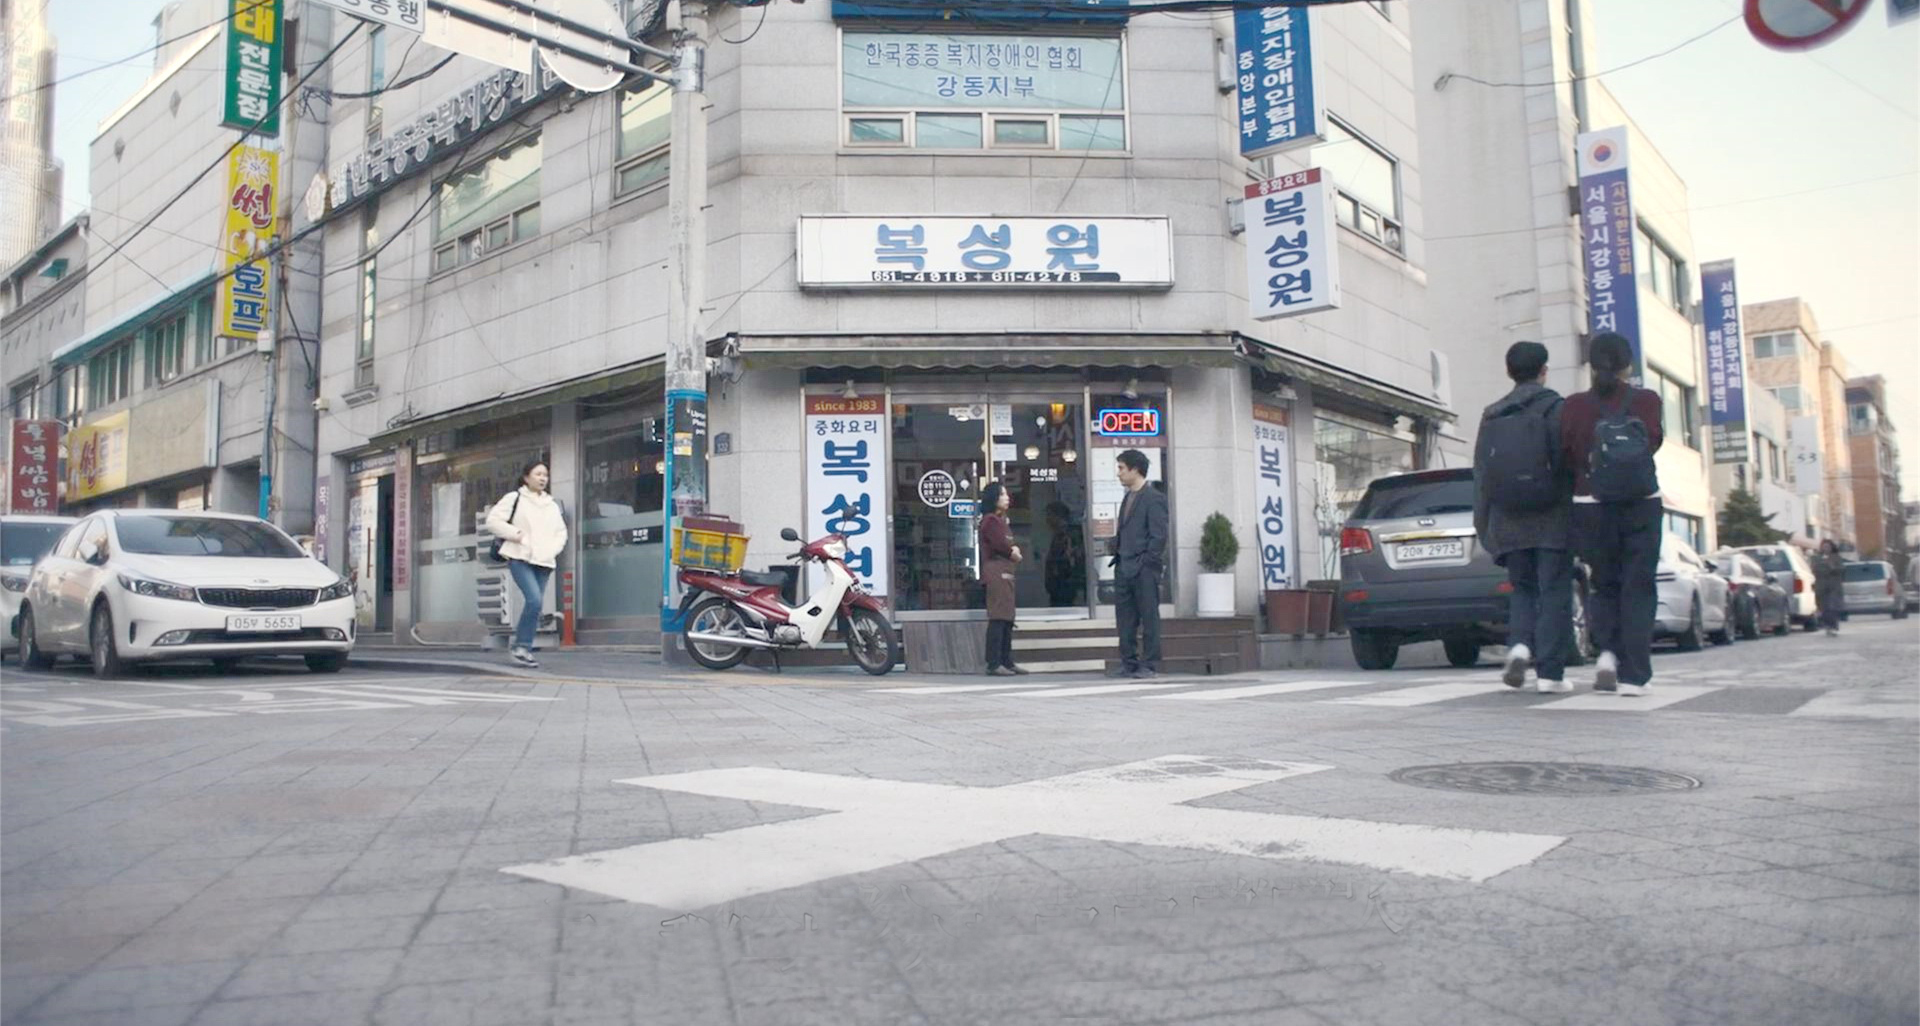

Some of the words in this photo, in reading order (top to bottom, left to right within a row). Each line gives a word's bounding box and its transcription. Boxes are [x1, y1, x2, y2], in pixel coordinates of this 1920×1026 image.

[234, 0, 275, 43] 태
[1047, 46, 1082, 70] 협회
[237, 41, 272, 123] 전문점
[937, 76, 1035, 98] 강동지부
[1239, 50, 1258, 137] 중앙본부
[1259, 172, 1307, 196] 중화요리
[231, 183, 272, 229] 썬
[874, 223, 1100, 271] 복성원
[1264, 191, 1313, 308] 복성원
[231, 263, 266, 333] 호프
[814, 401, 845, 411] since
[849, 400, 877, 411] 1983
[1103, 412, 1156, 432] OPEN
[815, 420, 878, 436] 중화요리
[1260, 444, 1286, 584] 복성원
[1428, 543, 1457, 556] 2973
[264, 617, 294, 629] 5653
